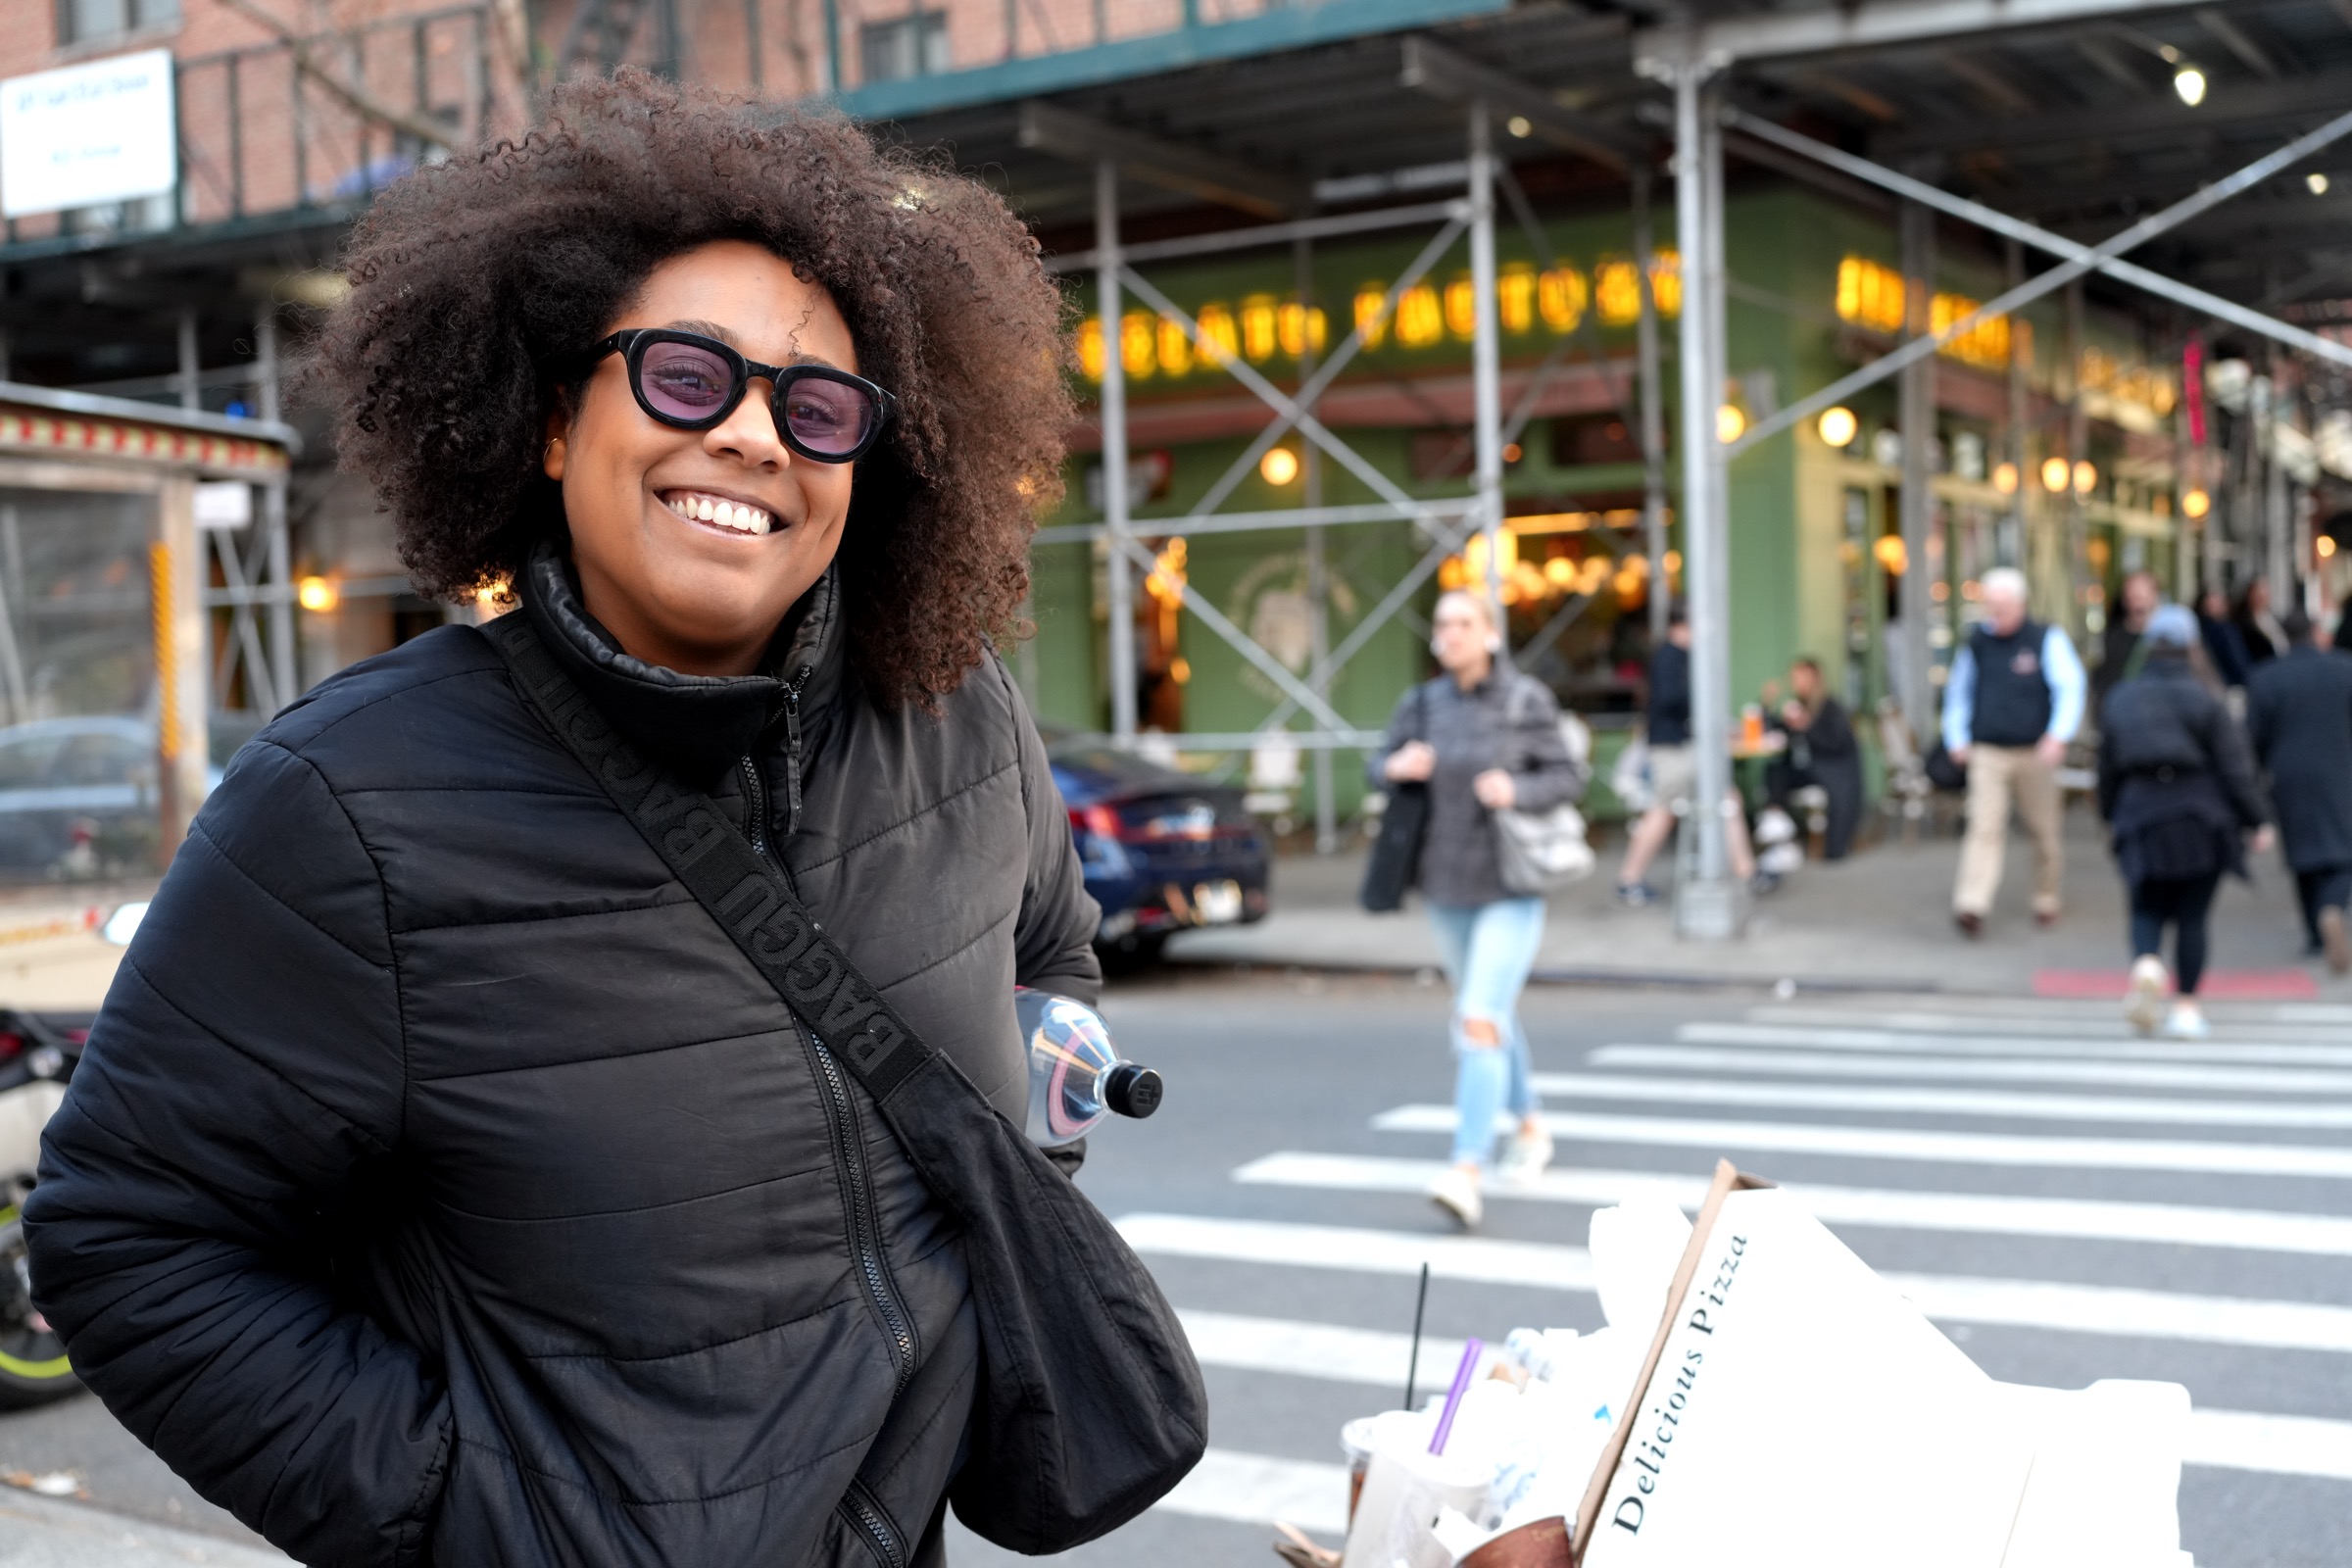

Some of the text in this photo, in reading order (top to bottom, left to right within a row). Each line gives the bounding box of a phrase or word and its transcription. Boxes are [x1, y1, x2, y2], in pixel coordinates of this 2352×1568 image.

[714, 870, 906, 1076] BAGGU
[1612, 1235, 1747, 1536] Delicious Pizza
